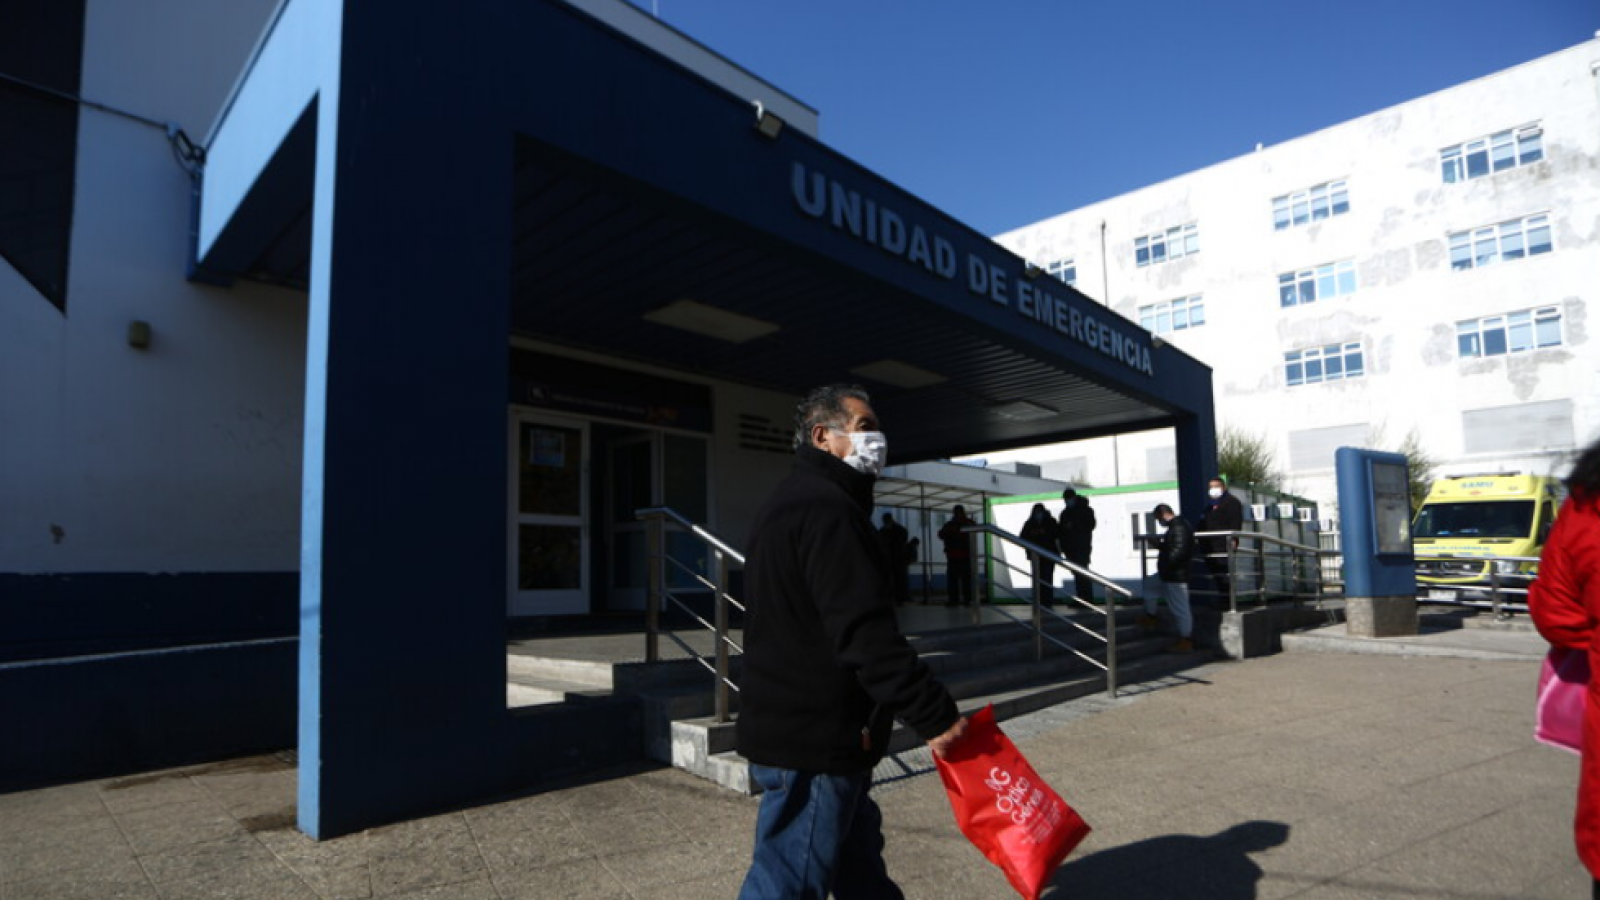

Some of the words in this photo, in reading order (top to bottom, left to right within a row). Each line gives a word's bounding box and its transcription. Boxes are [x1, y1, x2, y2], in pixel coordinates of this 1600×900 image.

[791, 161, 957, 280] UNIDAD
[968, 252, 1009, 305] DE
[1016, 279, 1154, 377] EMERGENCIA
